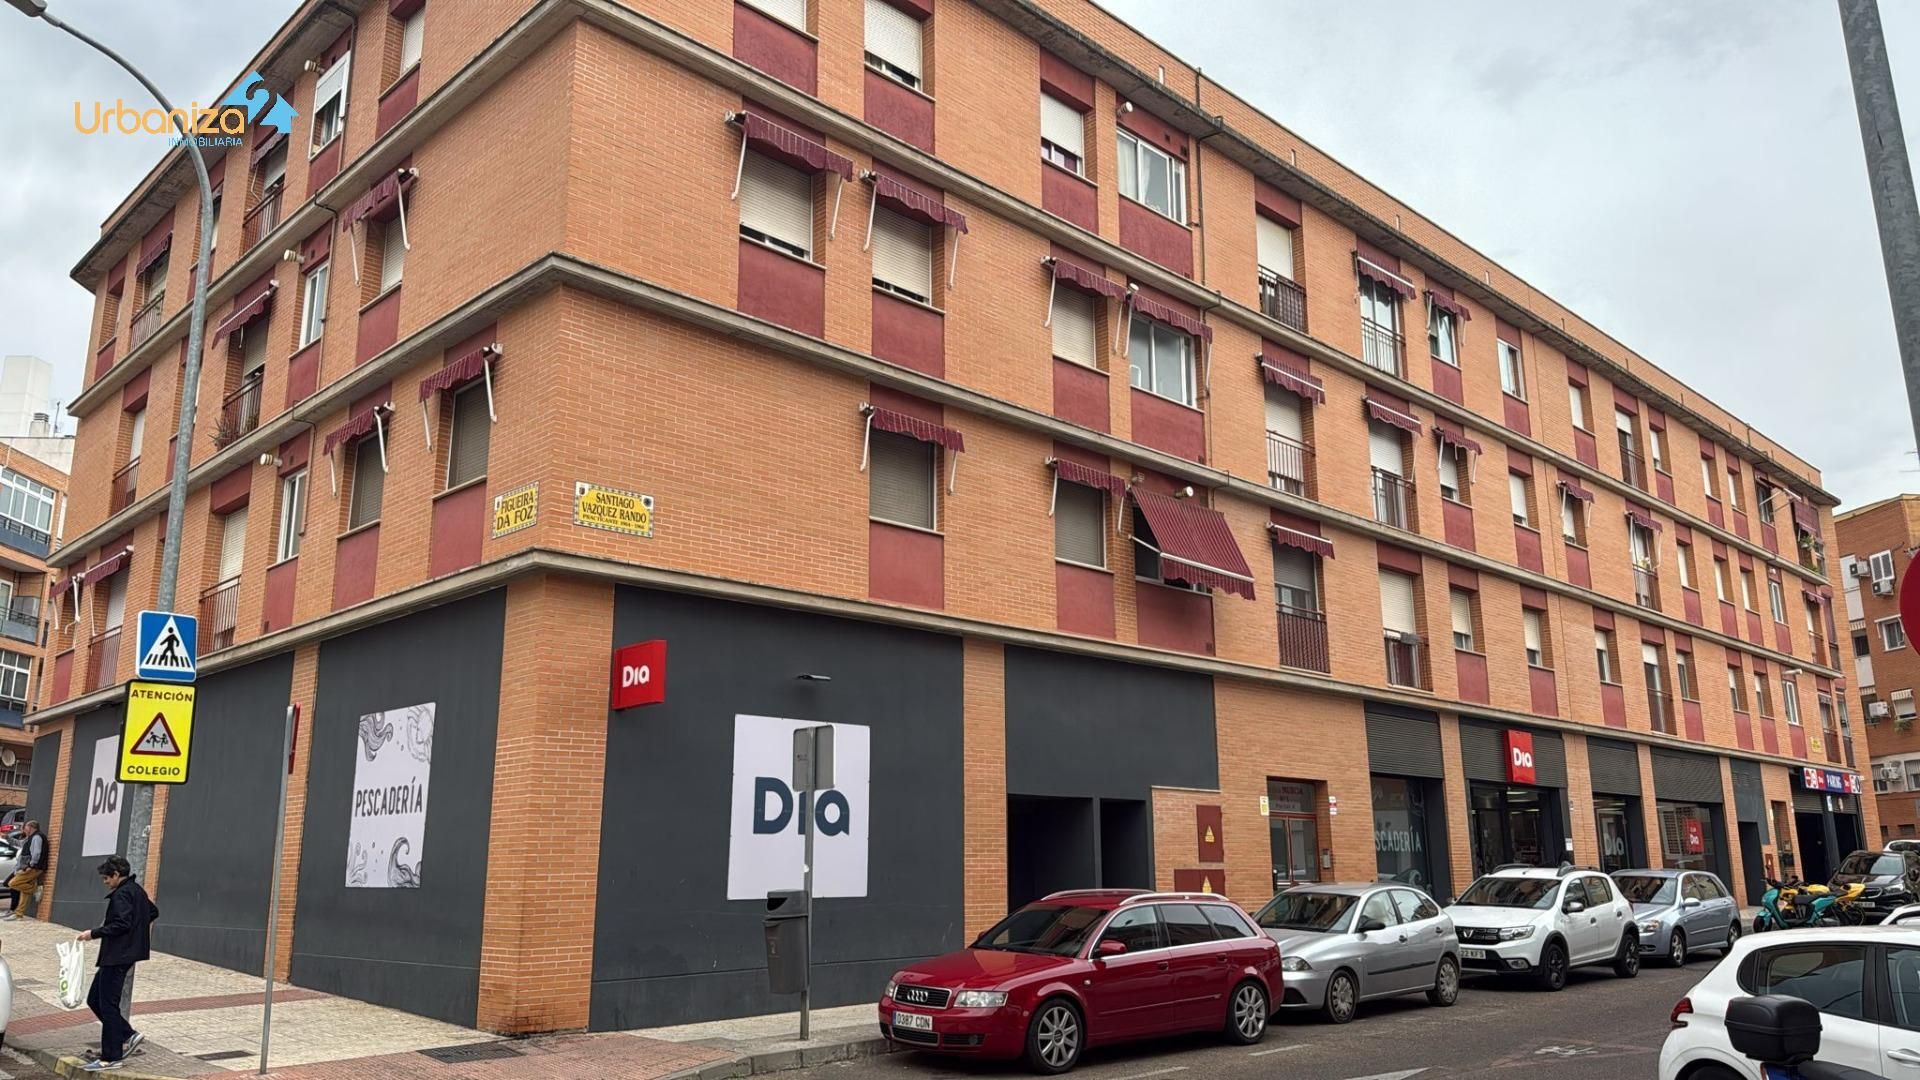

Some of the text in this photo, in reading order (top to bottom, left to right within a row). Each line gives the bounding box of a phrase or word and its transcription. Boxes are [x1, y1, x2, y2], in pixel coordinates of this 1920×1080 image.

[501, 490, 534, 514] FIGUEIRA
[595, 492, 635, 509] SANTIAGO
[496, 506, 534, 531] DA FOZ
[581, 501, 647, 523] VAZQUEZ RANDO
[622, 665, 650, 688] Dia
[131, 689, 193, 702] ATENCIÓN
[1513, 747, 1533, 768] Dia
[127, 765, 180, 776] COLEGIO
[92, 777, 119, 815] Dia
[354, 776, 423, 817] PESCADERÍA
[1375, 825, 1422, 852] SCADERÍA
[897, 1013, 914, 1026] 0387
